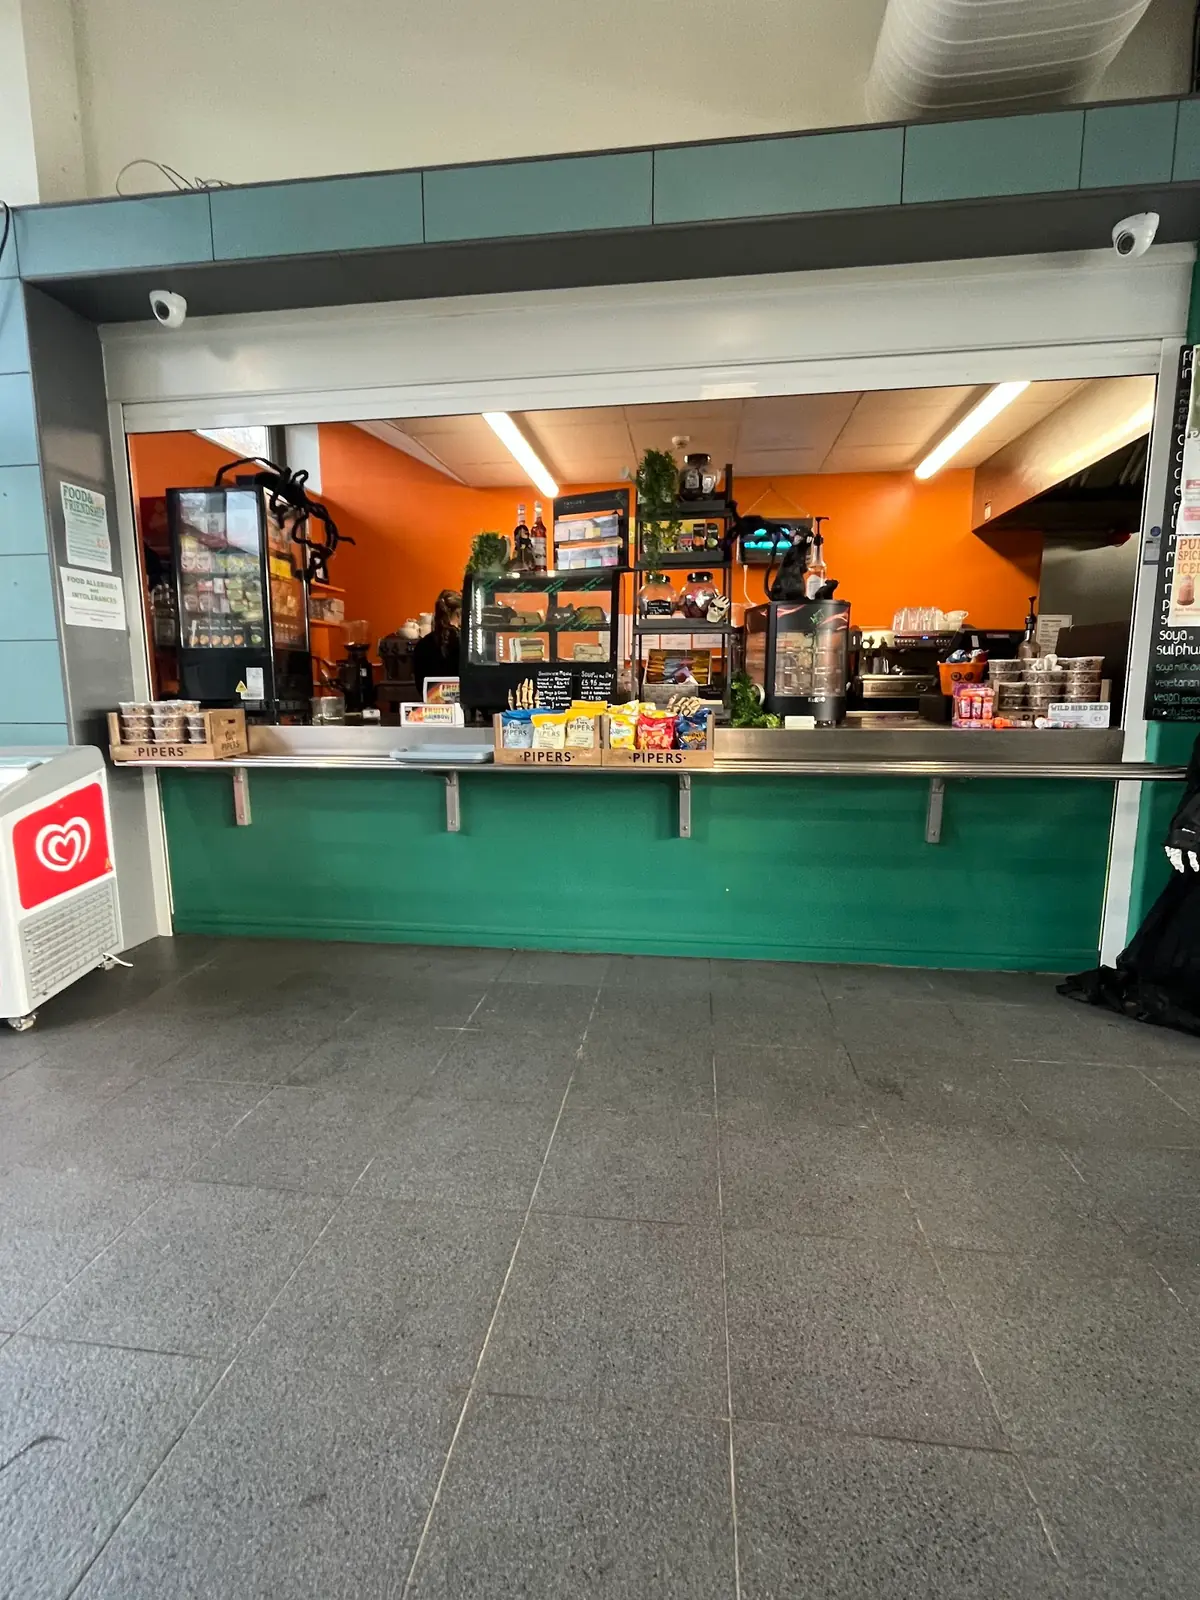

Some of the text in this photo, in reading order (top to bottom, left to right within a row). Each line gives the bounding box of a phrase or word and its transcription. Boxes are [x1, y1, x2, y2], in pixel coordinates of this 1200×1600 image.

[1179, 539, 1200, 550] PU
[67, 576, 86, 585] FOOD
[138, 747, 184, 757] PIPERS
[523, 751, 572, 762] PIPERS
[633, 752, 683, 764] PIPERS
